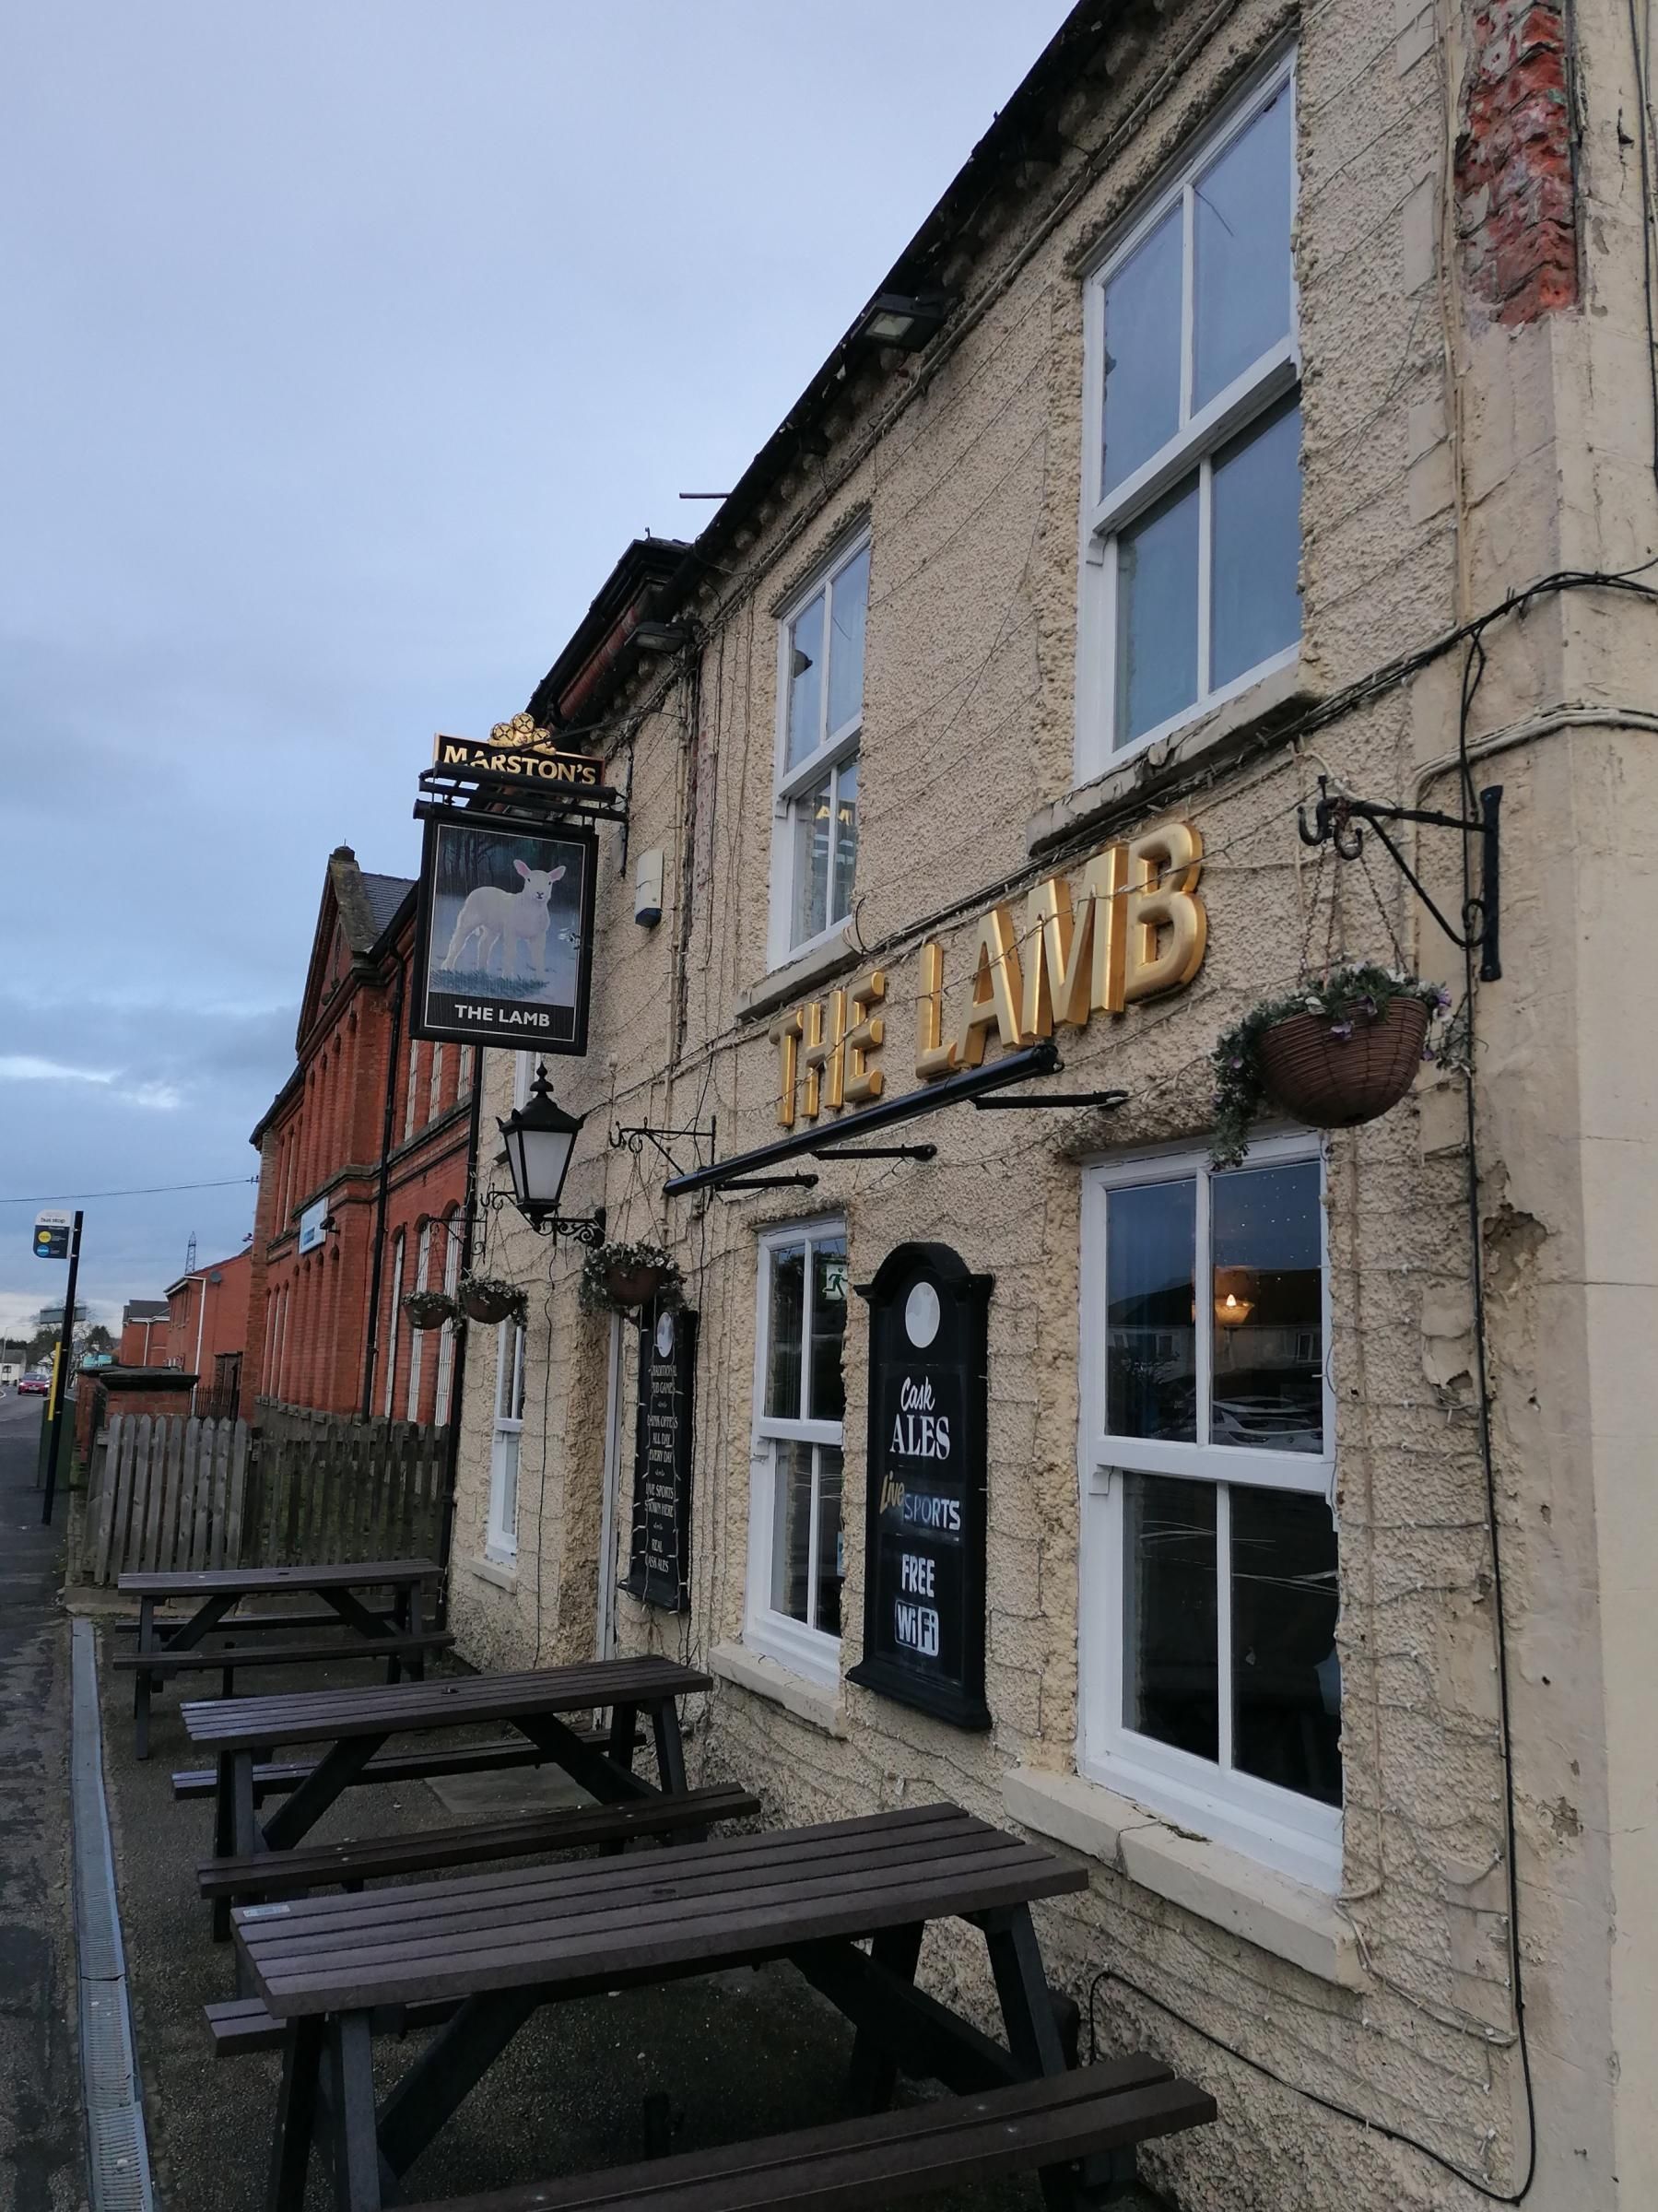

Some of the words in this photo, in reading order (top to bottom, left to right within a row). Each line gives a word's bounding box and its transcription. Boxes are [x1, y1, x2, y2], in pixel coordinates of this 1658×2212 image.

[443, 745, 596, 784] MARSTON'S
[769, 971, 886, 1128] THE
[916, 822, 1207, 1080] LAMB
[454, 1004, 494, 1021] THE
[499, 1008, 550, 1027] LAMB
[900, 1375, 935, 1412] Cask
[889, 1414, 950, 1461] ALES
[879, 1470, 905, 1514] Live
[904, 1493, 961, 1531] SPORTS
[901, 1553, 935, 1597] FREE
[896, 1601, 938, 1654] WiFi
